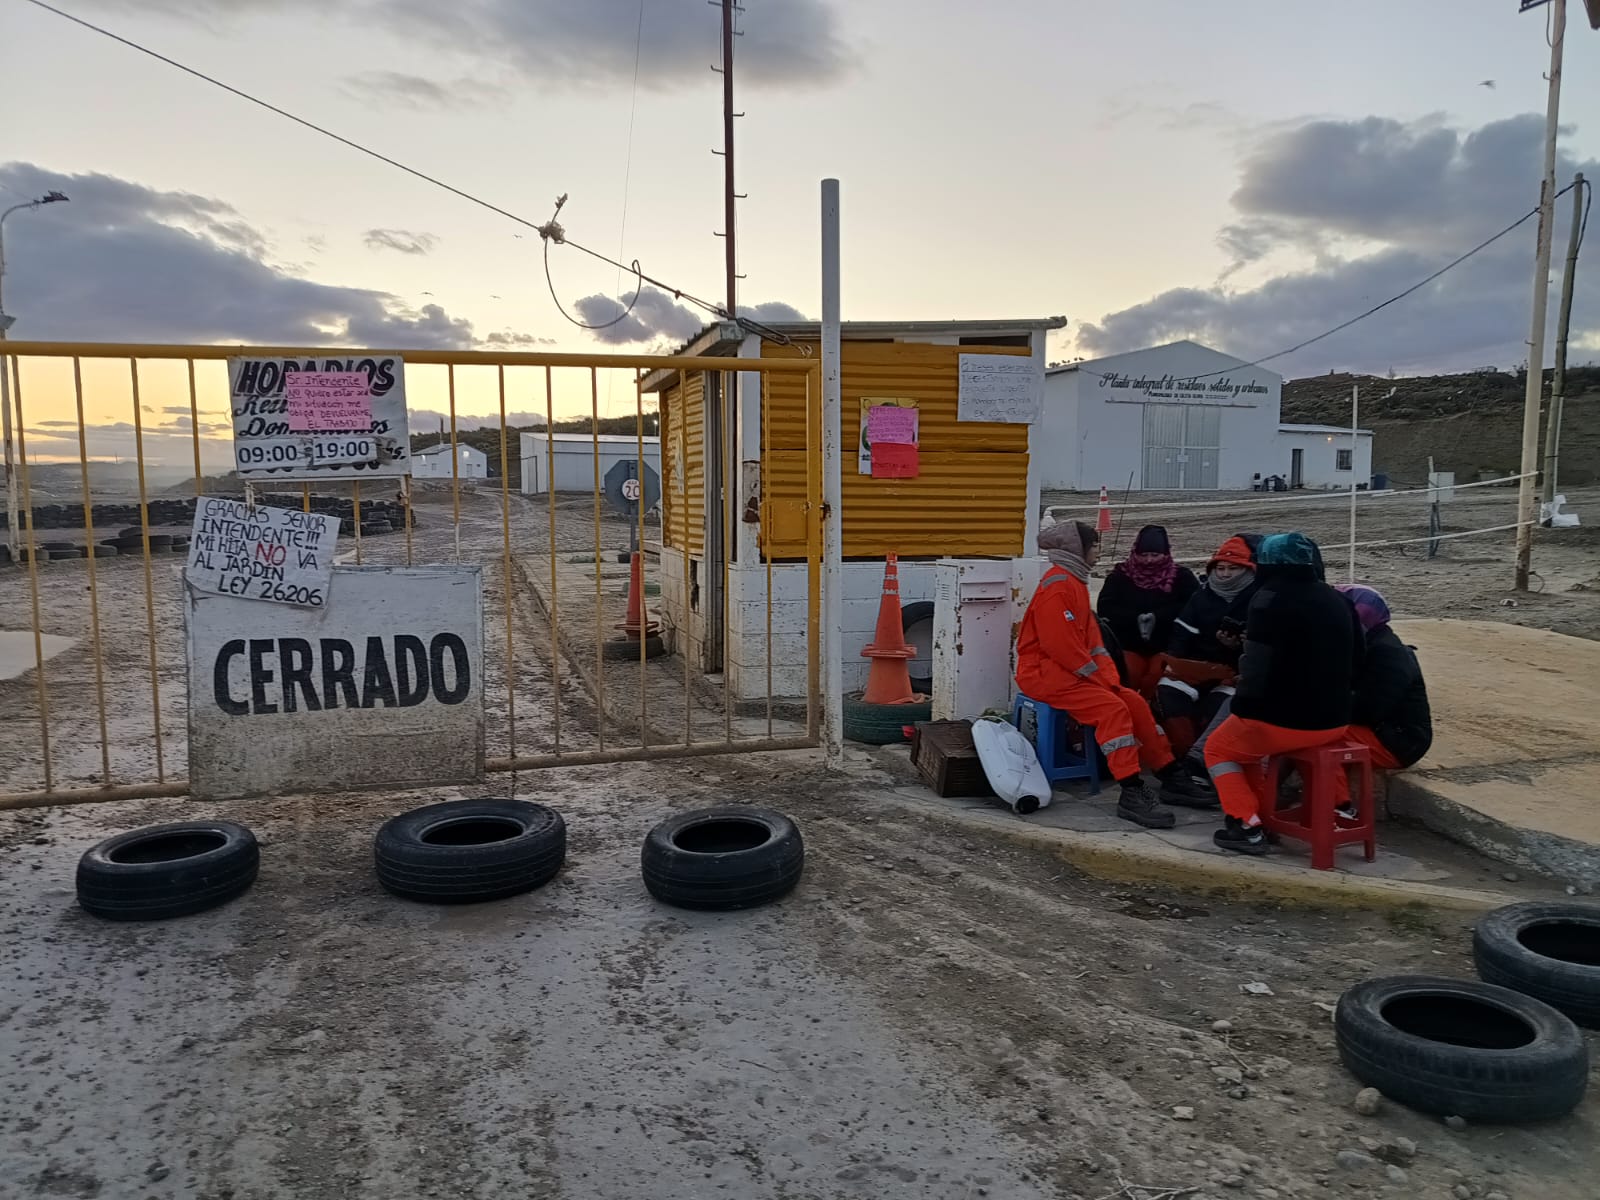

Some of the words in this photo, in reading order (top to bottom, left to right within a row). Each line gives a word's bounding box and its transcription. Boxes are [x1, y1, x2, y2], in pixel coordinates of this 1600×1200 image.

[305, 374, 361, 386] Intendente
[1099, 372, 1129, 388] Planta
[1165, 375, 1175, 390] de
[1232, 384, 1241, 398] y
[238, 445, 297, 464] 09:00
[315, 440, 370, 459] 19:00
[205, 499, 270, 524] GRACIAS
[194, 550, 215, 570] AL
[255, 540, 287, 567] NO
[298, 549, 318, 571] VA
[218, 574, 253, 595] LEY
[260, 580, 323, 606] 26206
[213, 632, 471, 716] CERRADO
